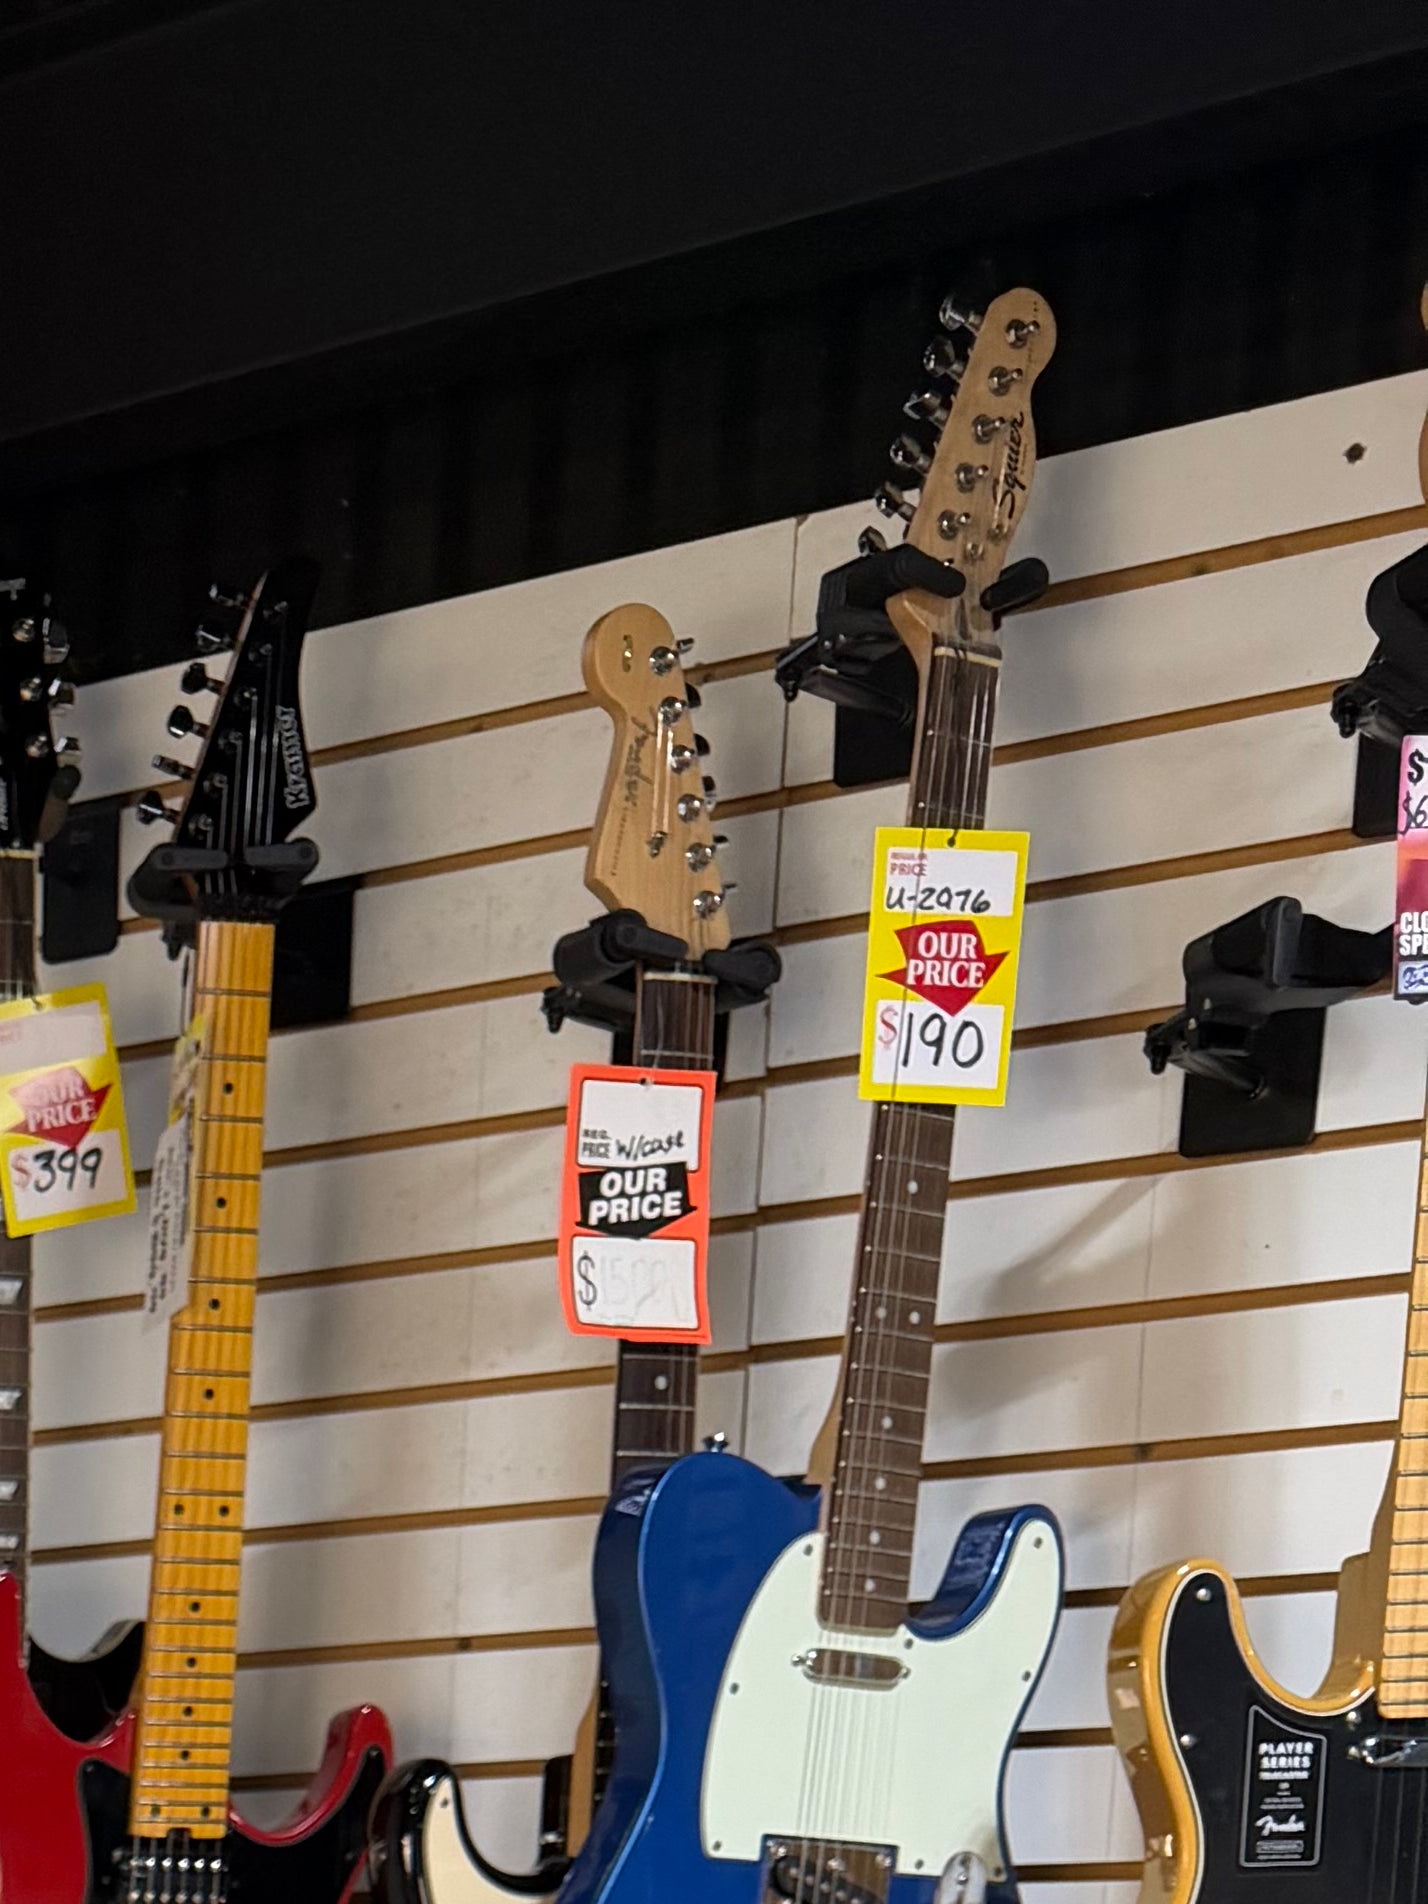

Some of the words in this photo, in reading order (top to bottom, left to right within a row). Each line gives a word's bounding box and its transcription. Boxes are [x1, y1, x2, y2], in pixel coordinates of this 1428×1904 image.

[890, 863, 928, 877] PRICE
[917, 931, 978, 960] OUR
[906, 960, 986, 988] PRICE
[878, 1005, 984, 1069] $190
[25, 1098, 97, 1133] PRICE
[11, 1146, 102, 1193] $399
[599, 1166, 667, 1198] OUR
[588, 1190, 683, 1227] PRICE
[1258, 1741, 1314, 1755] PLAYER
[1259, 1756, 1311, 1769] SERIES
